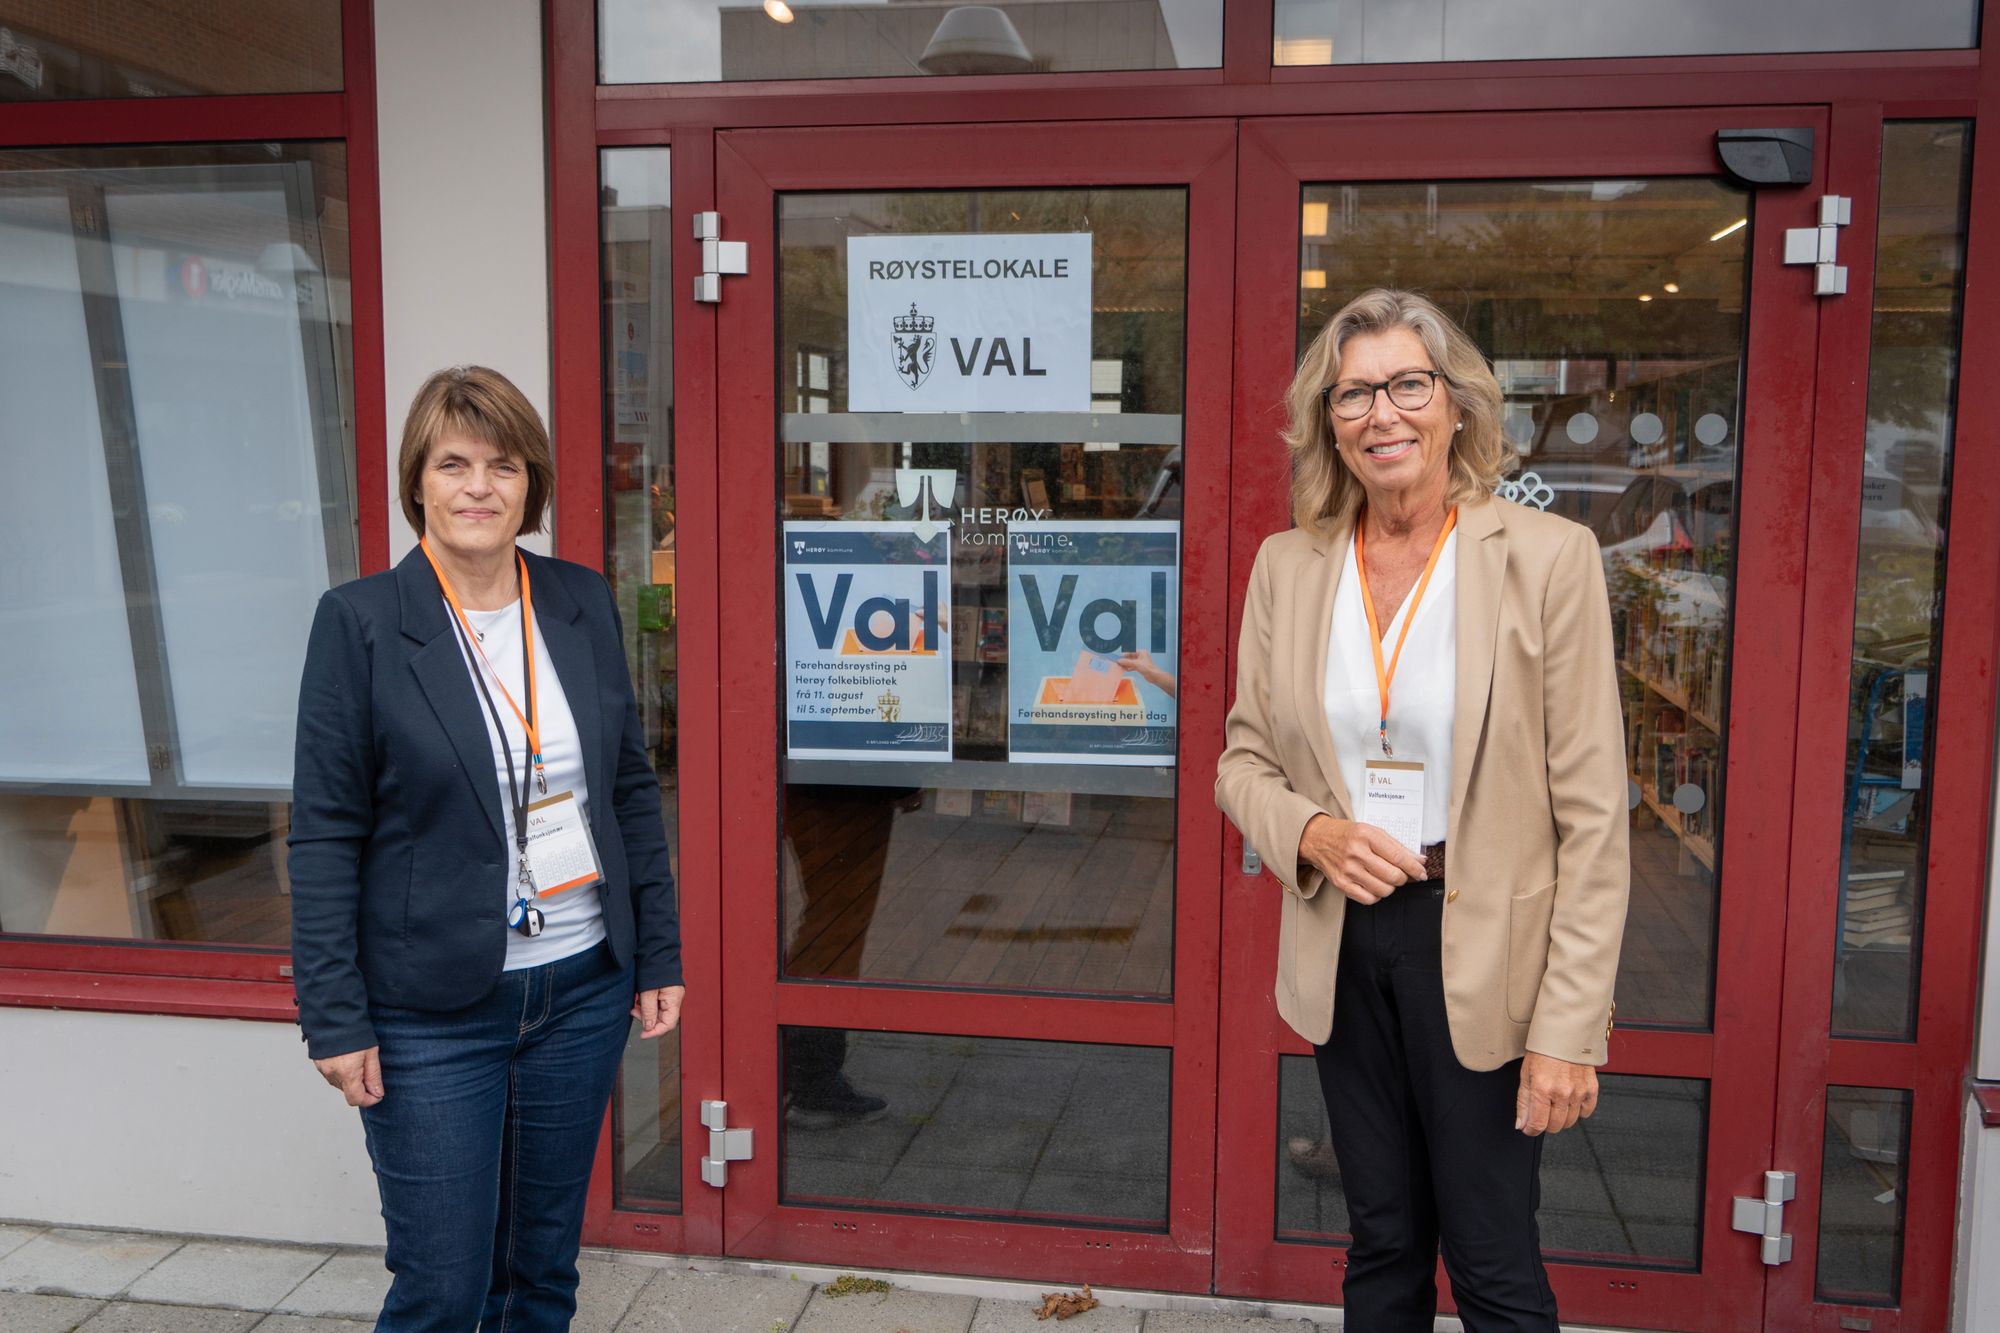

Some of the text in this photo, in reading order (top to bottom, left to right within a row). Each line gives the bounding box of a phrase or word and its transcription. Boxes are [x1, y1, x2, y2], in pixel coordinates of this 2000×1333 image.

[869, 259, 1069, 280] RØYSTELOKALE
[950, 337, 1047, 376] VAL
[961, 507, 1044, 525] HERØY
[795, 570, 939, 651] Val
[1018, 571, 1167, 654] Val
[795, 660, 907, 673] Førehandsrøysting på
[795, 675, 898, 687] Herøy folkebibliotek
[796, 690, 864, 702] frå 11. august
[796, 704, 876, 717] til 5. september
[1018, 708, 1168, 722] Førehandsrøysting her i dag
[1377, 776, 1392, 785] VAL
[529, 816, 546, 826] VAL
[529, 826, 563, 841] alfunksjonær
